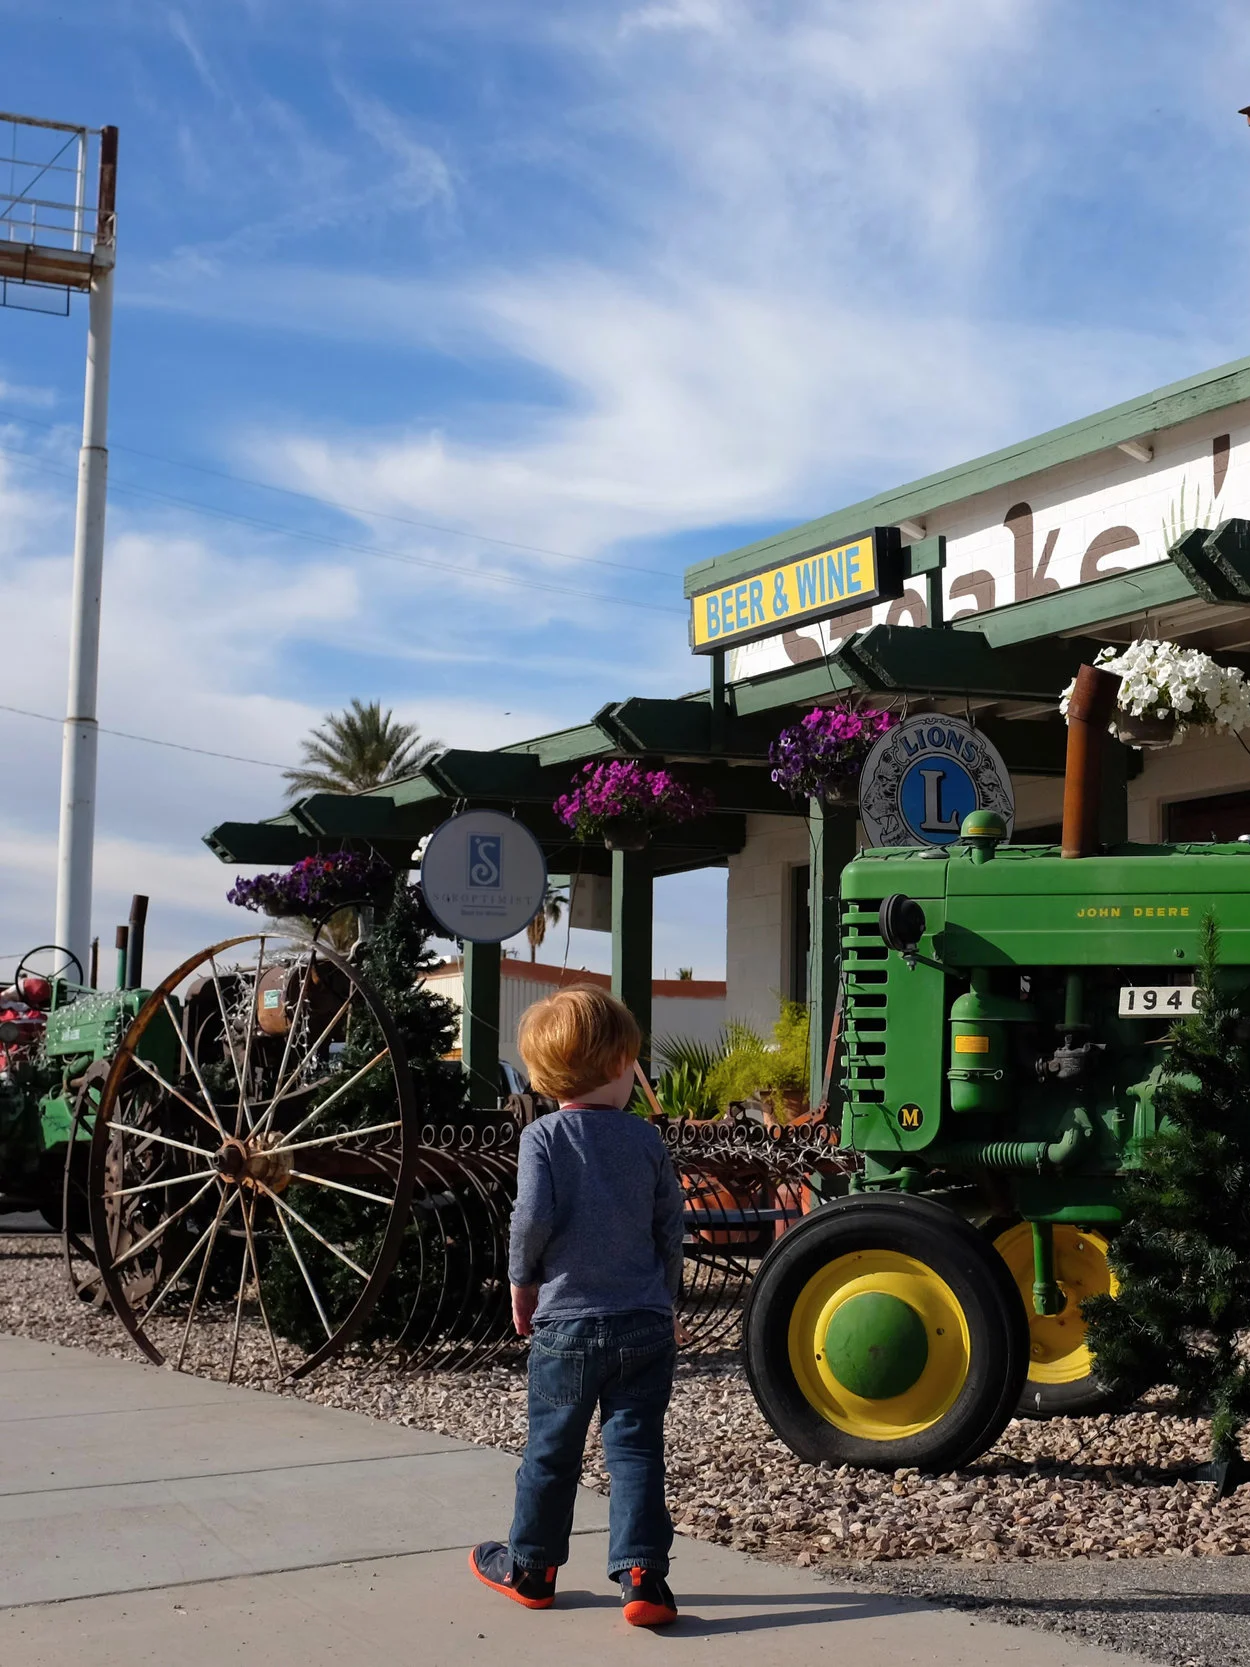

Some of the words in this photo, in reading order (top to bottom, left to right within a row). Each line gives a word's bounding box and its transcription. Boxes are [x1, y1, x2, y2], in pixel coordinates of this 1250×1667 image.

[706, 579, 765, 639] BEER
[773, 571, 789, 617] &
[796, 546, 862, 609] WINE
[900, 727, 978, 762] LIONS
[919, 769, 960, 834] L
[1077, 907, 1121, 917] JOHN
[1133, 907, 1190, 917] DEERE
[901, 1108, 920, 1127] M
